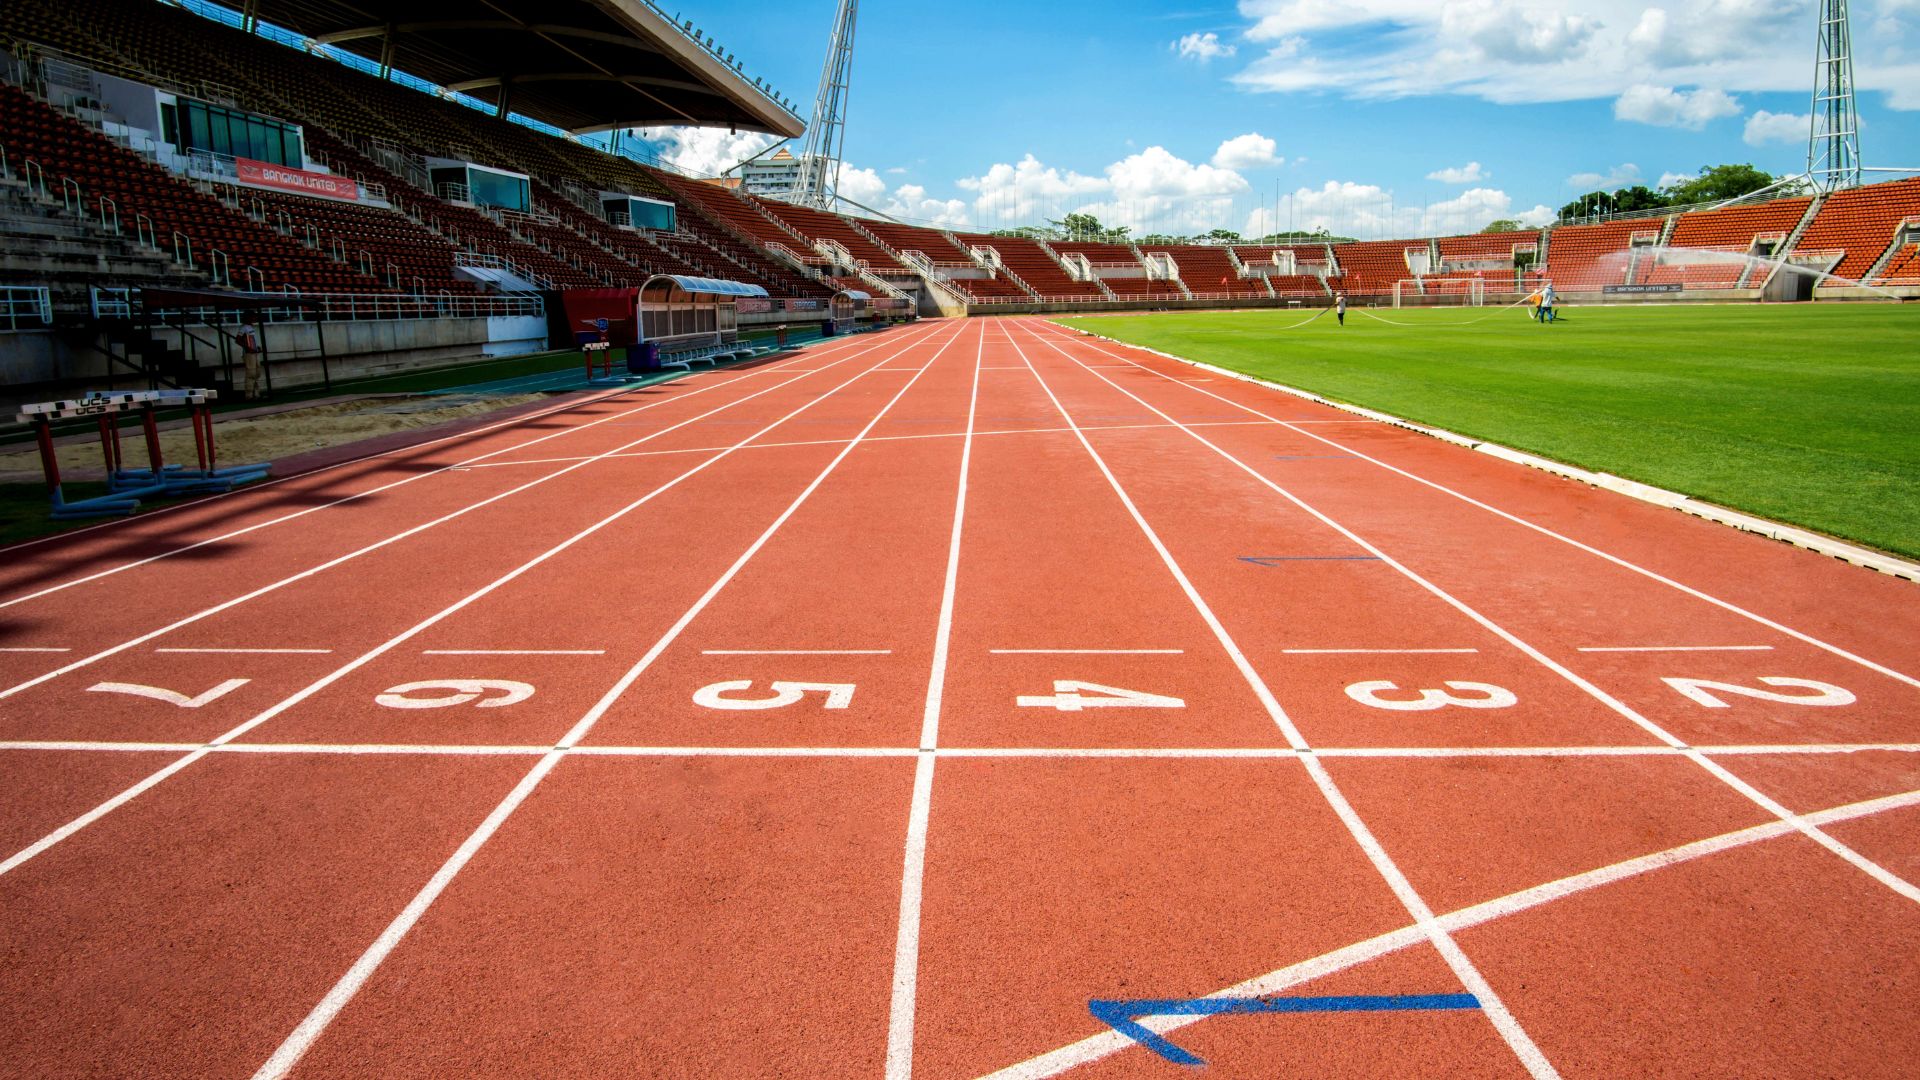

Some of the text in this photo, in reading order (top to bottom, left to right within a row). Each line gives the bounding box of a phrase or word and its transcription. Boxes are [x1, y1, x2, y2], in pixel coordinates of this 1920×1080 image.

[262, 168, 336, 192] BANGKOK UNITED
[75, 405, 106, 415] UCS
[80, 396, 111, 407] UCS
[86, 679, 251, 708] 7
[375, 679, 536, 709] 6
[692, 680, 857, 711] 5
[1017, 680, 1187, 711] 4
[1344, 680, 1518, 711] 3
[1660, 676, 1857, 708] 2
